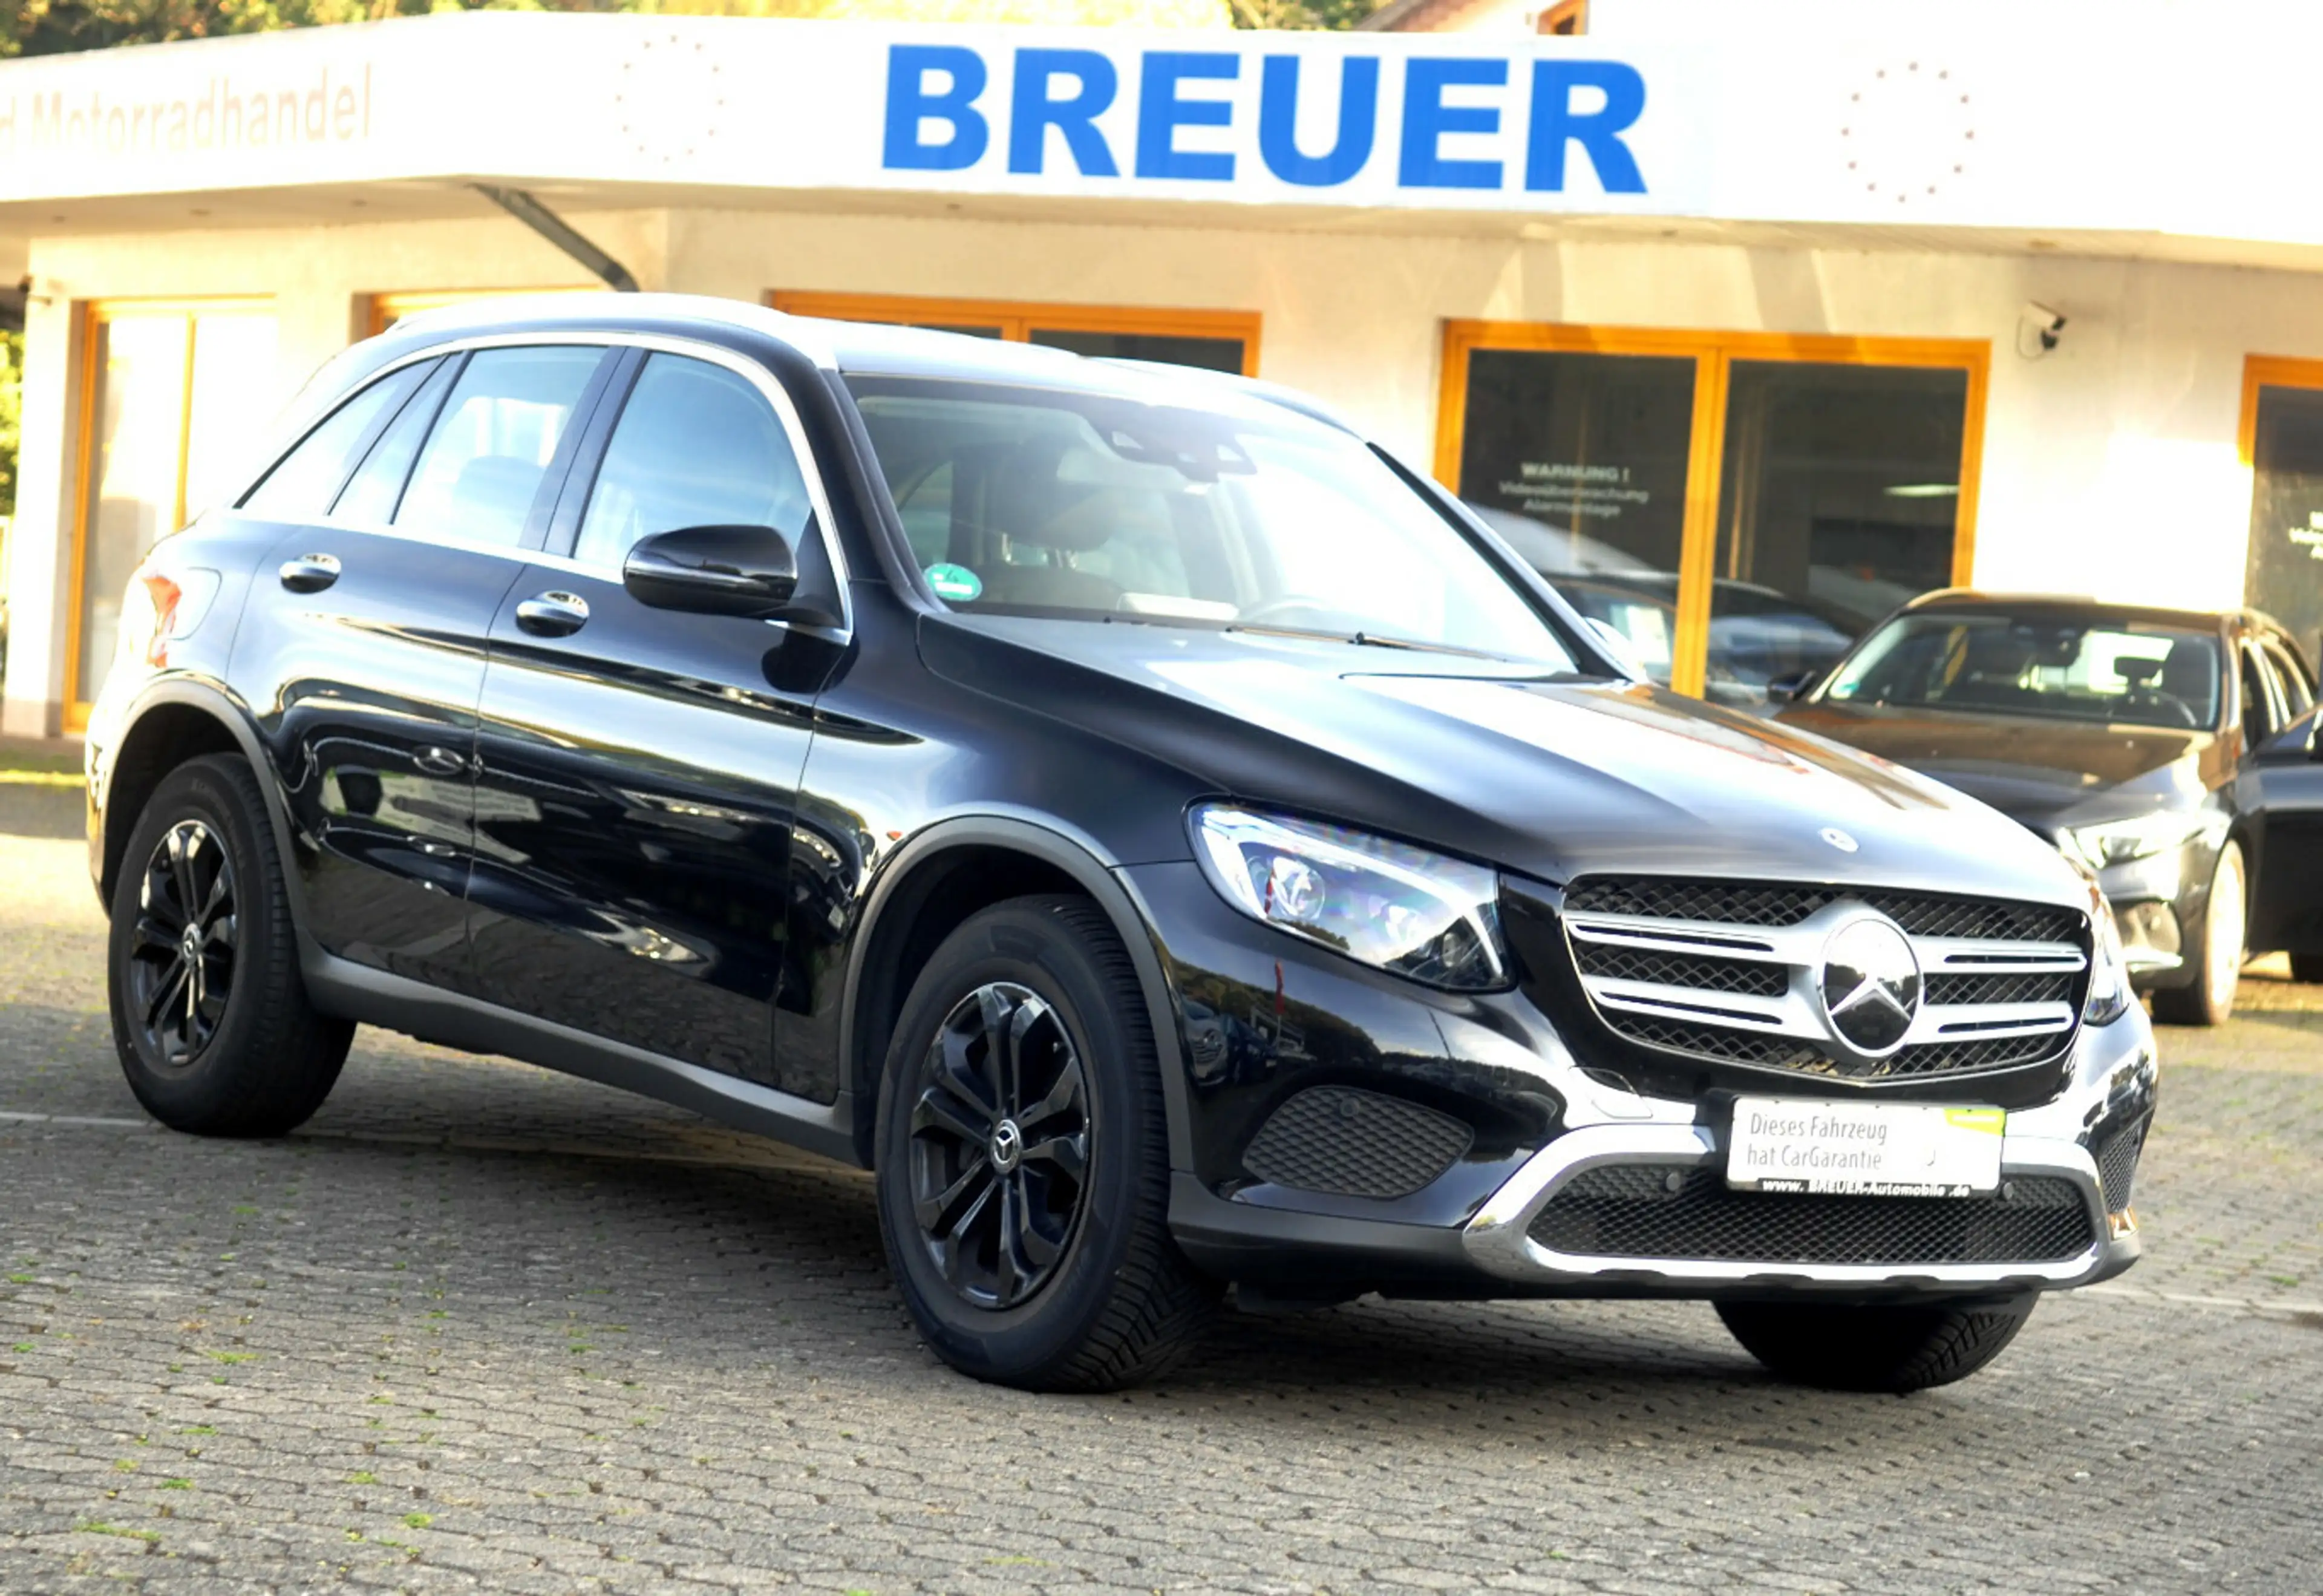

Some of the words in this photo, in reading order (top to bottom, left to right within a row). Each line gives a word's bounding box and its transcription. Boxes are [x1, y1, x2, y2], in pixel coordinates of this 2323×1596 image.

[31, 61, 371, 154] Motorradhandel
[882, 44, 1648, 194] BREUER
[1521, 462, 1619, 482] WARNUNG
[1750, 1112, 1805, 1137] Dieses
[1810, 1115, 1887, 1146] Fahrzeug
[1746, 1142, 1776, 1167] hat
[1780, 1144, 1883, 1171] CarGarantie
